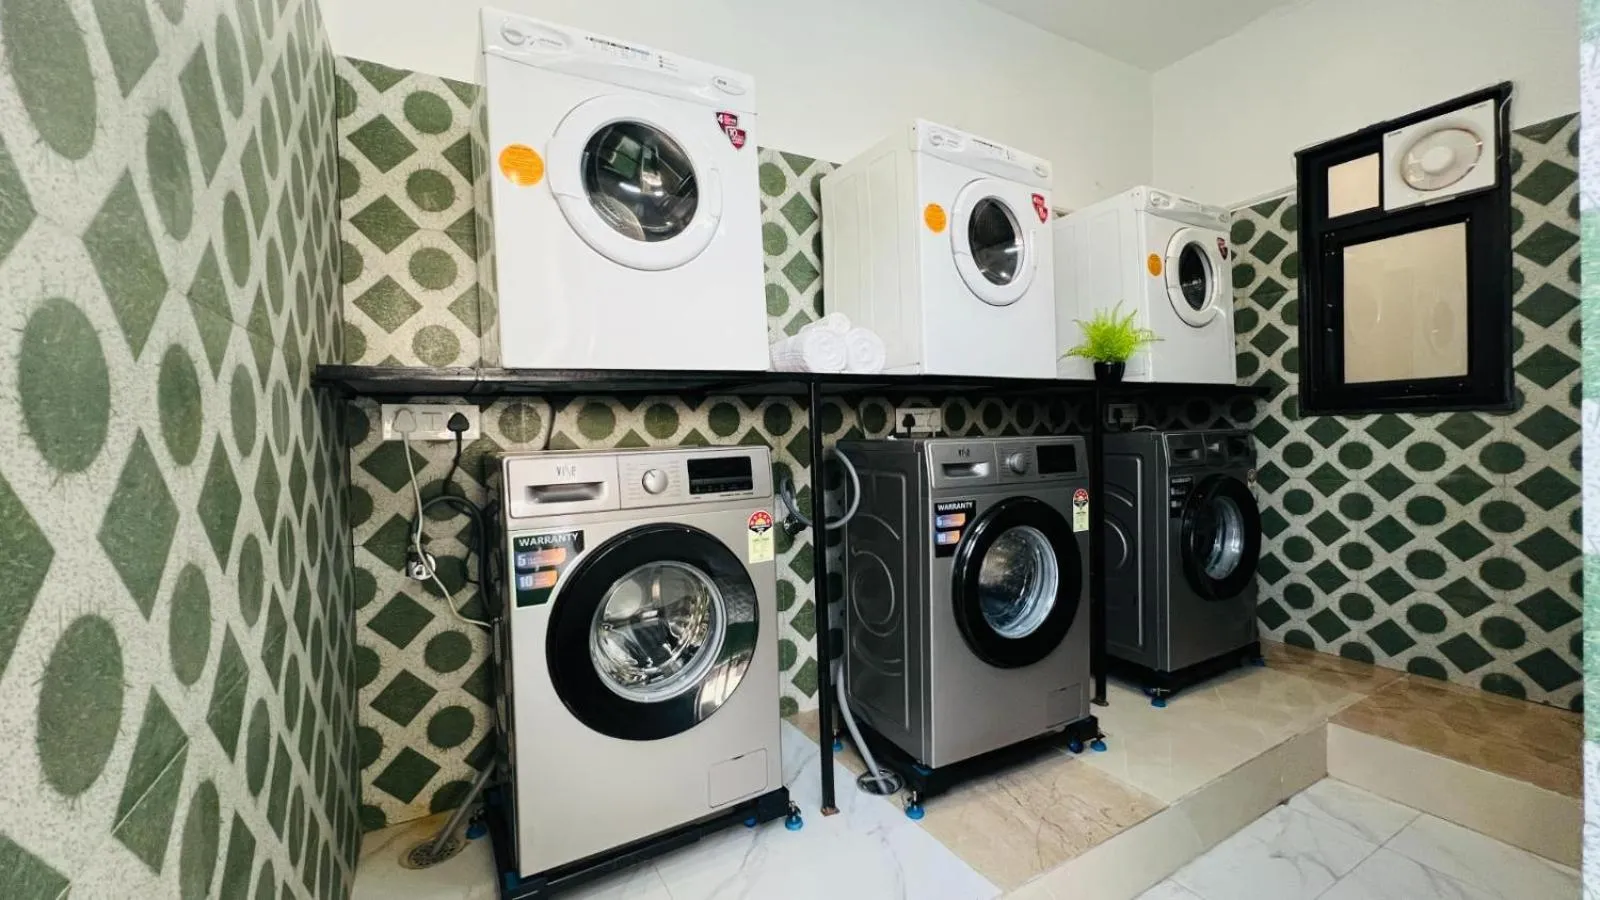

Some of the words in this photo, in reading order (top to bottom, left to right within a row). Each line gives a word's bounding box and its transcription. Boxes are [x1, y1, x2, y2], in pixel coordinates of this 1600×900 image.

[937, 501, 973, 511] WARRANTY
[518, 532, 579, 547] WARRANTY
[517, 554, 526, 567] 5
[519, 575, 533, 588] 10
